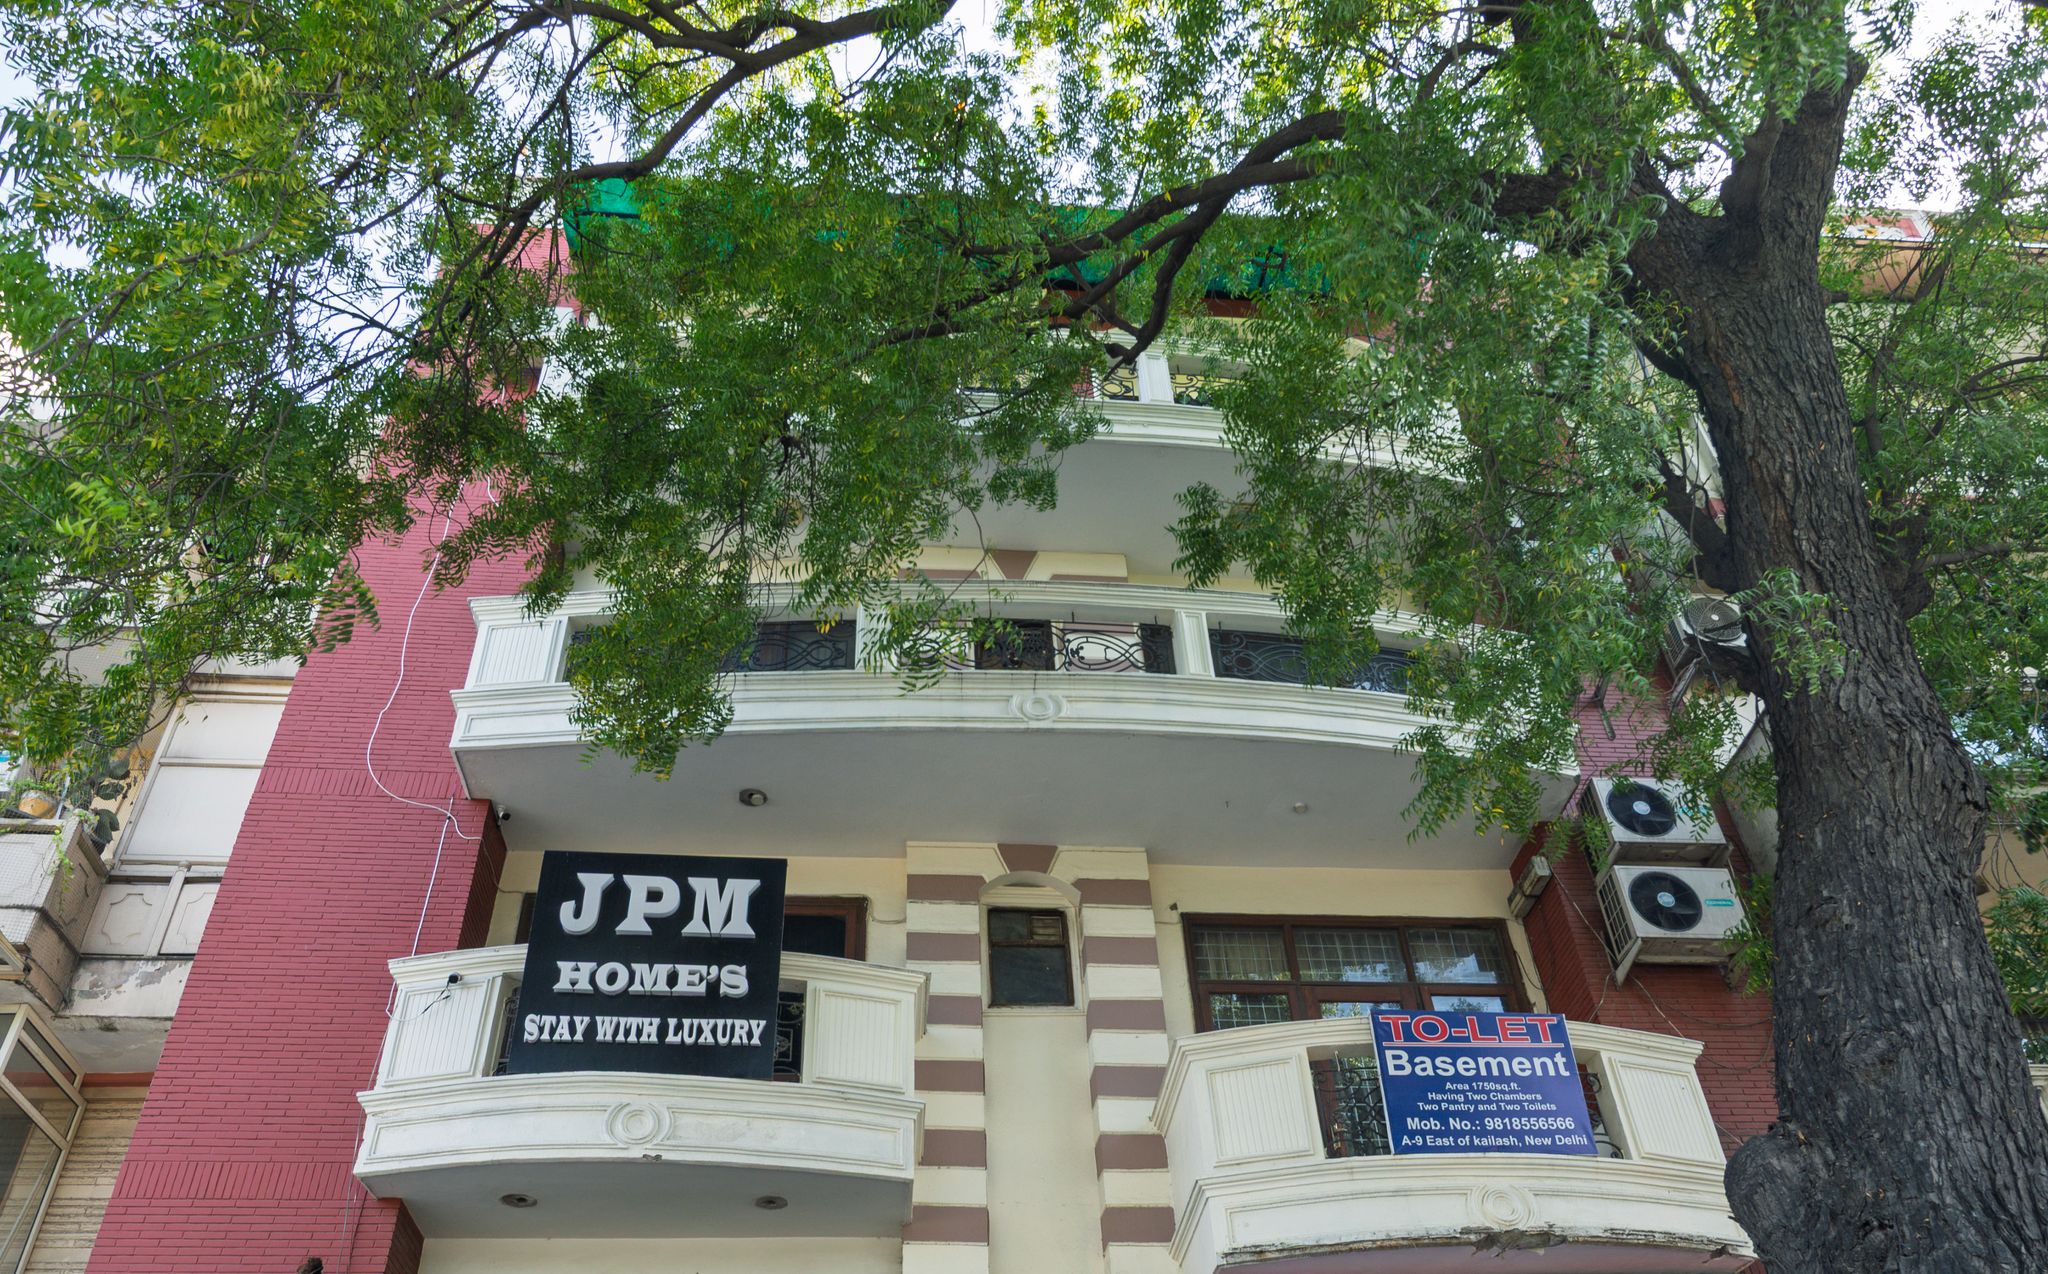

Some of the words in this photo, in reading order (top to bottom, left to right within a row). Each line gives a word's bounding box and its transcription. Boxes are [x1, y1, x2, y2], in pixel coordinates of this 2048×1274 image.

[559, 872, 761, 939] JPM
[552, 960, 750, 999] HOME'S
[523, 1013, 591, 1043] STAY
[595, 1015, 661, 1045] WITH
[664, 1017, 767, 1047] LUXURY
[1379, 1015, 1558, 1043] TO-LET
[1384, 1049, 1571, 1077] Basement
[1445, 1081, 1470, 1091] Area
[1471, 1081, 1522, 1092] 1750sq.ft.
[1427, 1092, 1465, 1102] Having
[1466, 1092, 1488, 1101] Two
[1489, 1092, 1543, 1101] Chambers
[1417, 1103, 1439, 1111] Two
[1440, 1103, 1475, 1112] Pantry
[1477, 1103, 1497, 1111] and
[1499, 1103, 1521, 1111] Two
[1522, 1103, 1557, 1111] Toilets
[1406, 1117, 1446, 1130] Mob.
[1449, 1117, 1481, 1130] No.:
[1484, 1117, 1576, 1130] 9818556566
[1401, 1135, 1423, 1146] A-9
[1426, 1135, 1455, 1146] East
[1457, 1135, 1470, 1146] of
[1473, 1135, 1522, 1147] kailash,
[1525, 1135, 1552, 1146] New
[1555, 1134, 1588, 1146] Delhi
